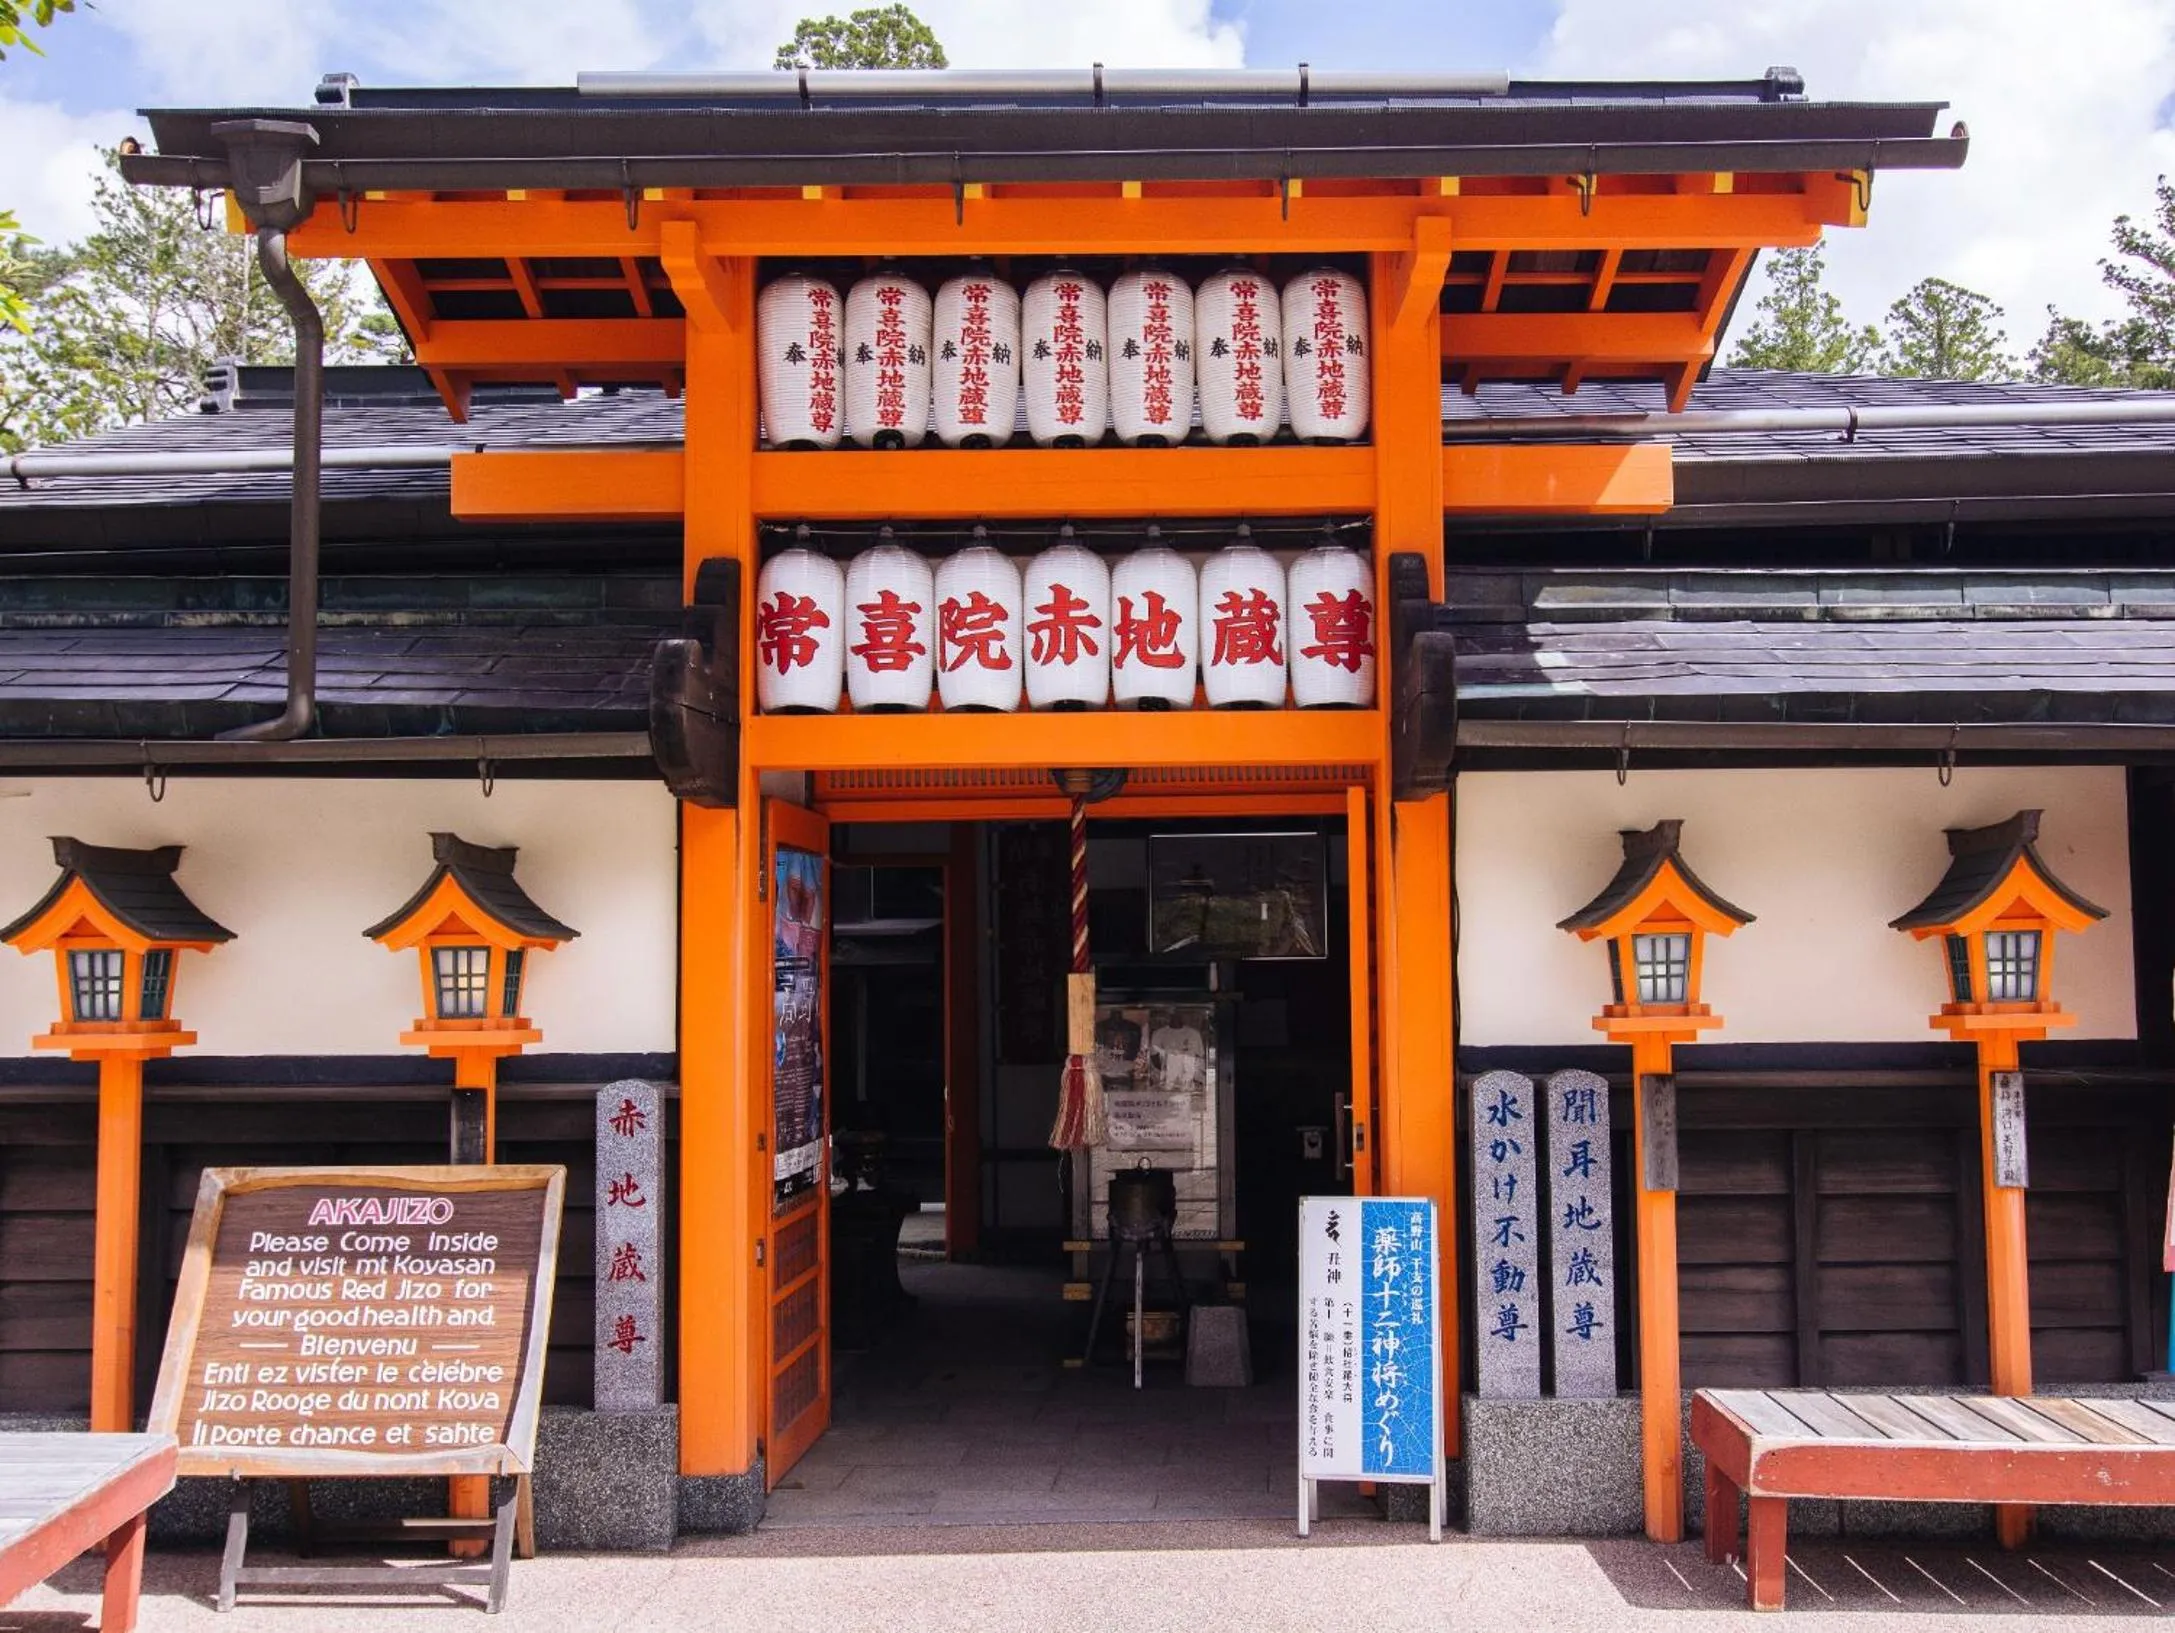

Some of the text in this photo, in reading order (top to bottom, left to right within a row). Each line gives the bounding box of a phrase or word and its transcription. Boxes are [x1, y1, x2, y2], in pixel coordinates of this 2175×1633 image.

[784, 341, 806, 366] 奉
[855, 341, 874, 365] 奉
[908, 344, 926, 366] 納
[875, 286, 907, 428] 常喜院赤地蔵尊
[940, 339, 1011, 366] 奉 納
[958, 283, 992, 425] 常喜院赤地蔵尊
[1032, 338, 1102, 361] 奉 納
[1053, 282, 1085, 425] 常喜院赤地蔵尊
[1121, 337, 1190, 361] 奉 納
[1143, 281, 1173, 425] 常喜院赤地蔵尊
[1209, 336, 1279, 359] 奉 納
[1230, 280, 1264, 421] 常喜院赤地蔵尊
[1294, 334, 1364, 358] 奉 納
[1311, 279, 1347, 419] 常喜院赤地蔵尊
[808, 288, 836, 433] 常喜院赤地蔵尊
[308, 1197, 455, 1226] AKAJIZO
[1486, 1089, 1529, 1342] 水かけ不動尊
[1562, 1088, 1604, 1341] 聞耳地蔵尊
[607, 1098, 647, 1356] 赤地蔵尊
[1410, 1211, 1423, 1251] 高野山
[250, 1232, 498, 1252] Please Come Inside
[246, 1254, 495, 1277] and visit mt Koyasan
[239, 1278, 493, 1300] Famous Red Jizo for
[232, 1311, 291, 1328] your
[294, 1306, 359, 1332] good
[363, 1305, 442, 1326] health
[301, 1336, 417, 1356] Bienvenu
[1371, 1226, 1403, 1468] 薬師十二神将めぐり
[258, 1366, 287, 1382] ez
[377, 1363, 398, 1382] le
[198, 1390, 246, 1413] Jizo
[338, 1389, 368, 1410] du
[437, 1389, 500, 1410] Koya
[290, 1423, 375, 1445] chance
[386, 1423, 411, 1444] et
